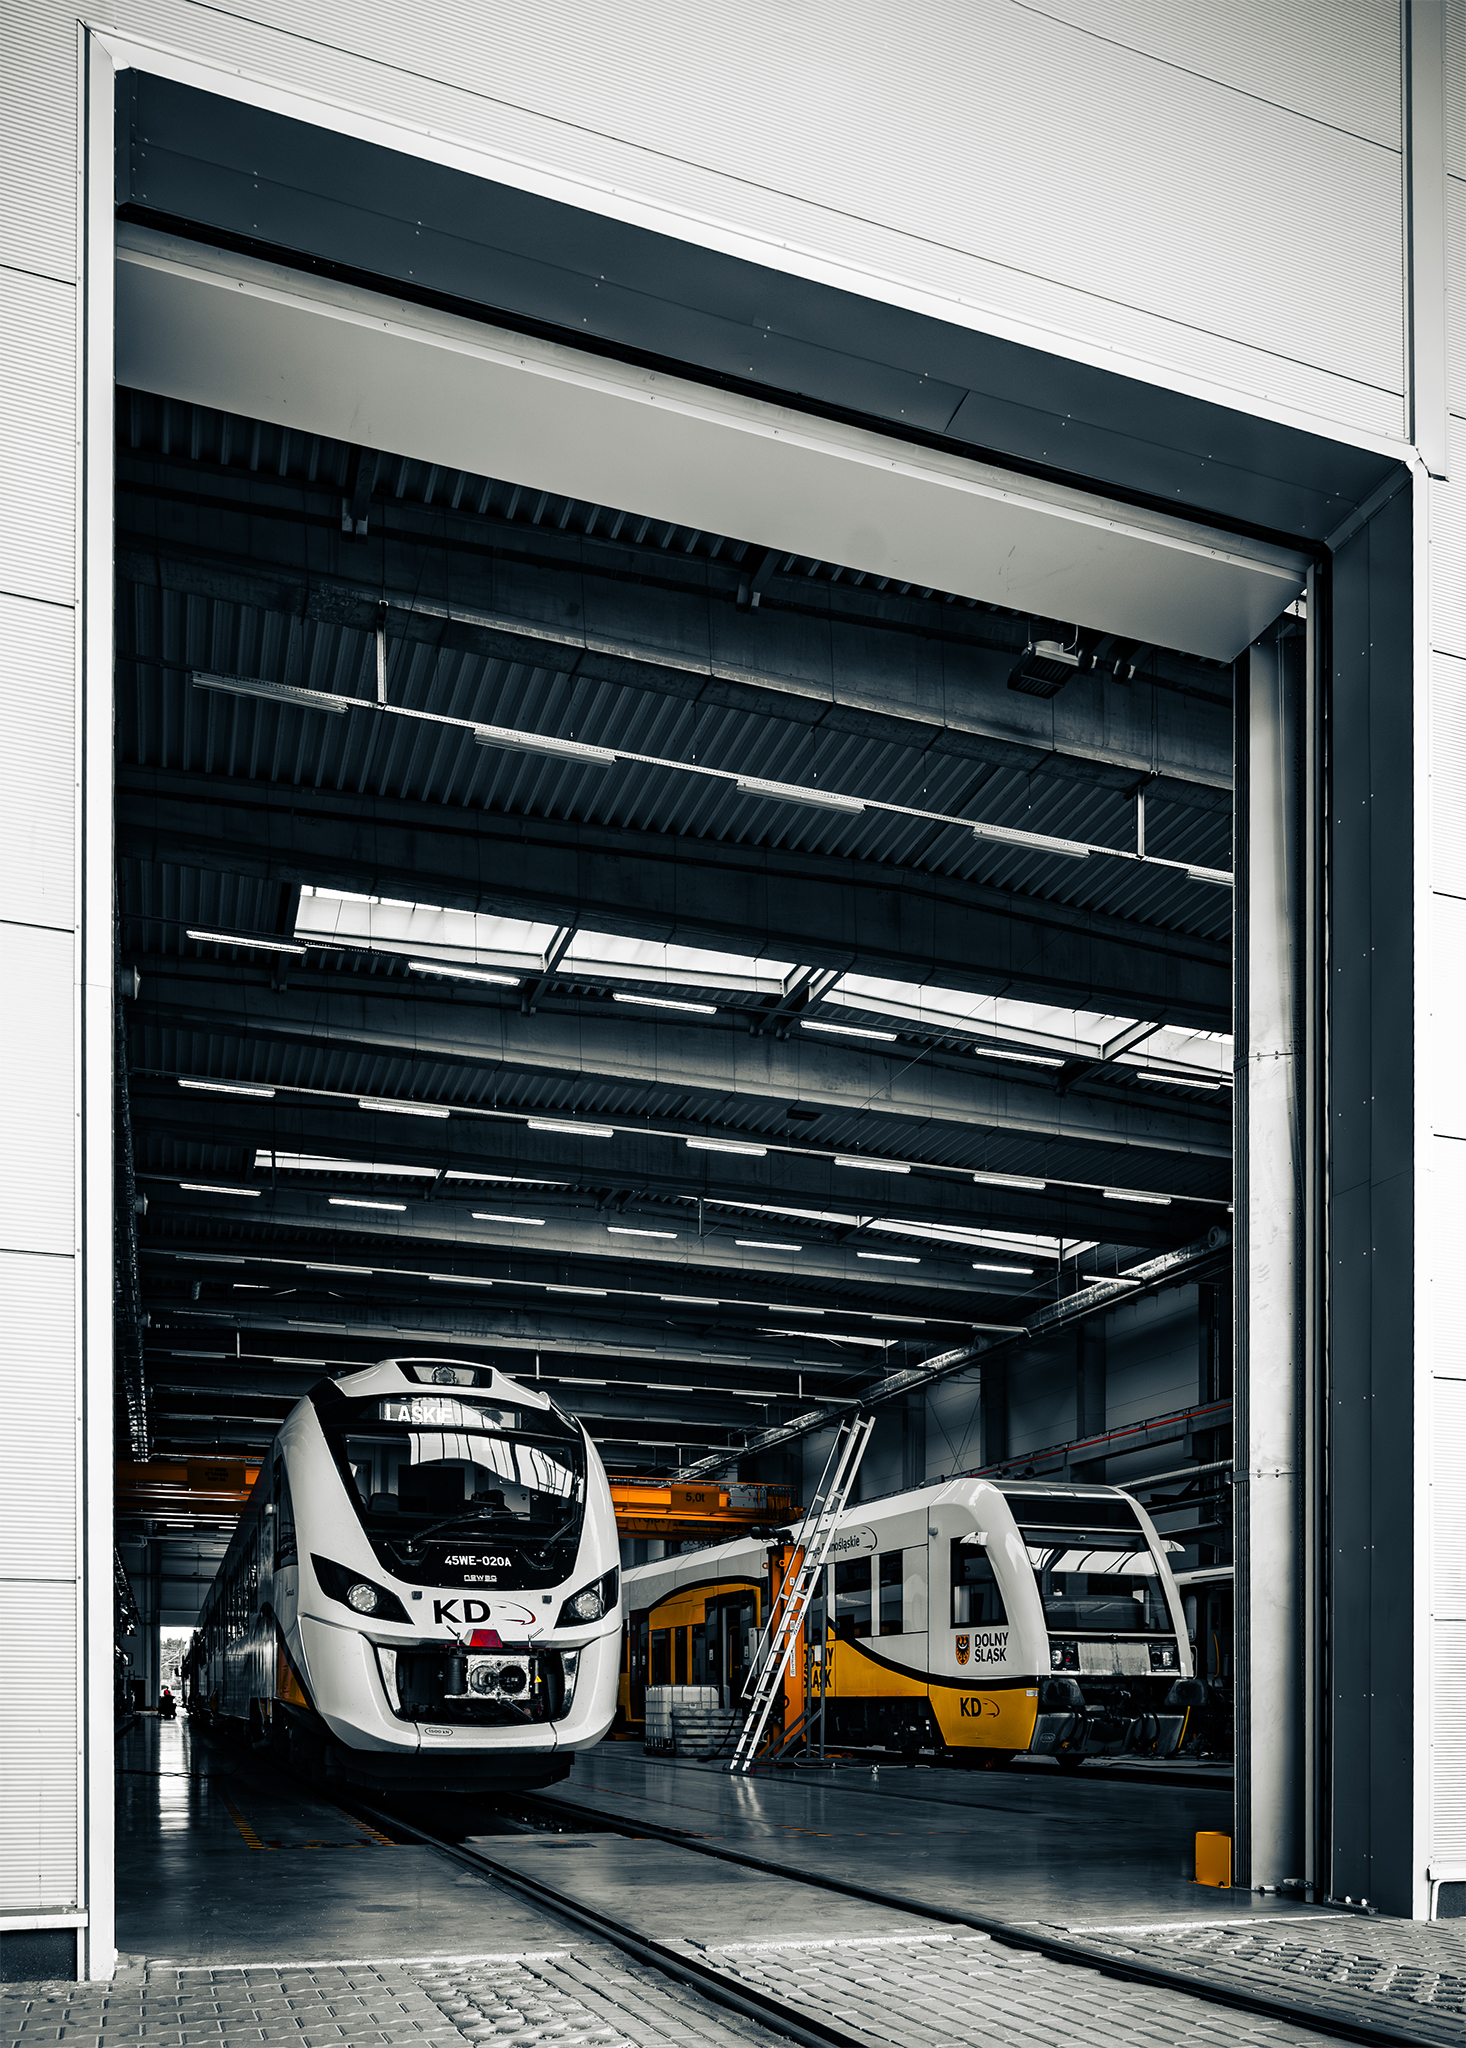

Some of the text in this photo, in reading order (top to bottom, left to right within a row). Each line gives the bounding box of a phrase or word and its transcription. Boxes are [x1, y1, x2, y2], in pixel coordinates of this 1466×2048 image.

[685, 1492, 705, 1503] 5,0t
[444, 1555, 512, 1567] 45WE-020A
[433, 1599, 491, 1624] KD
[974, 1632, 1009, 1647] DOLNY
[974, 1645, 1007, 1664] ŚLĄSK
[960, 1697, 982, 1717] KD
